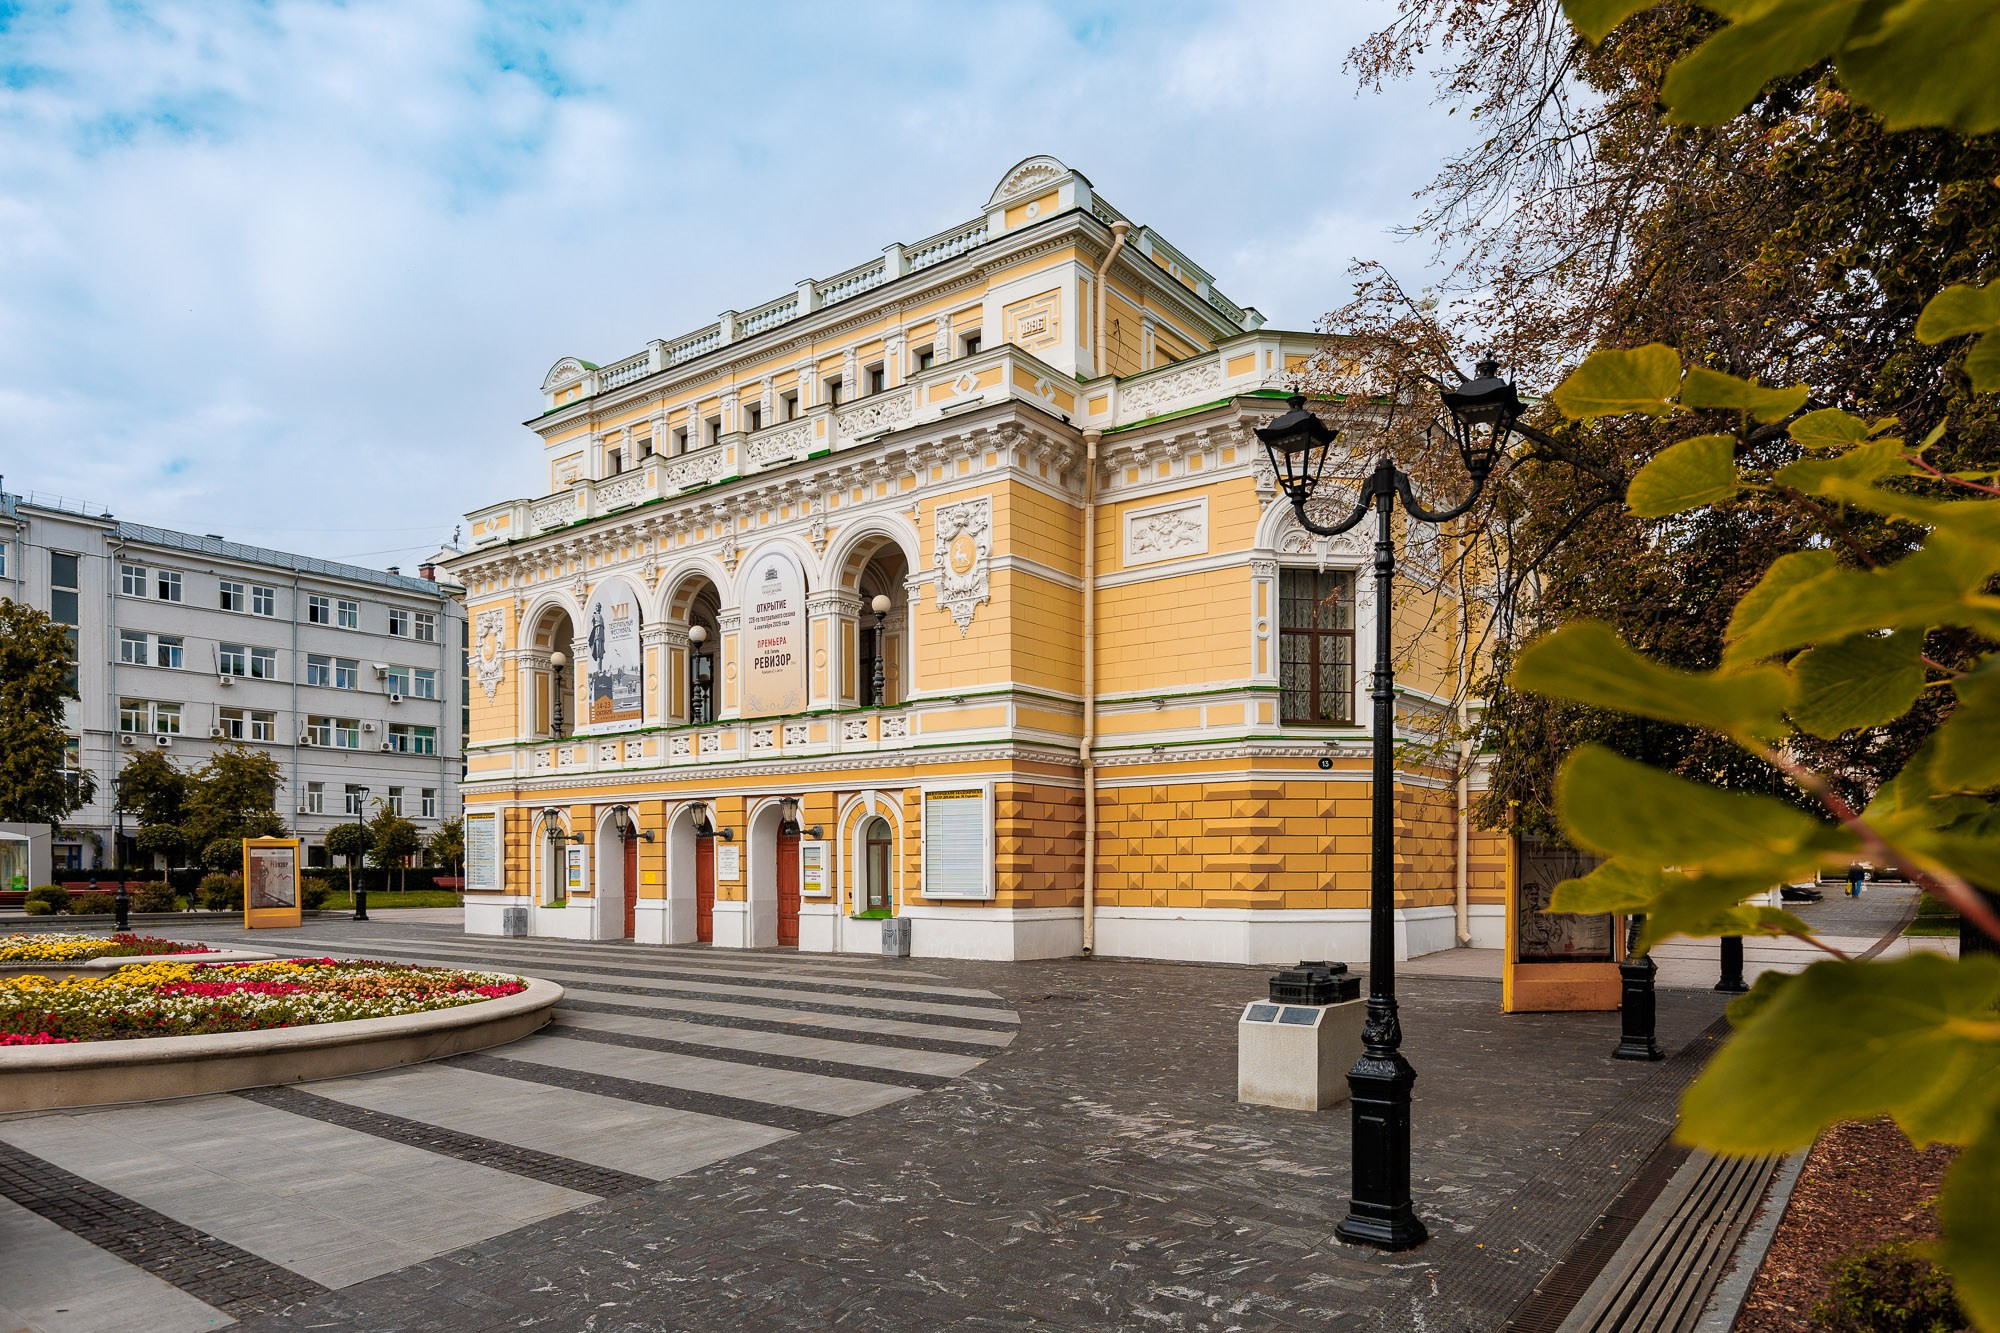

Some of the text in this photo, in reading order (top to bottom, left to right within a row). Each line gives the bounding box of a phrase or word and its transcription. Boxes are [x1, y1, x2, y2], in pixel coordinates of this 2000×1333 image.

[1021, 317, 1044, 335] 1896
[610, 603, 629, 620] VII
[756, 599, 787, 613] ОТКРЫТИЕ
[760, 613, 783, 622] театрального
[757, 636, 787, 648] ПРЕМЬЕРА
[754, 653, 792, 670] РЕВИЗОР
[596, 701, 611, 709] 14-23
[1321, 760, 1330, 768] 13
